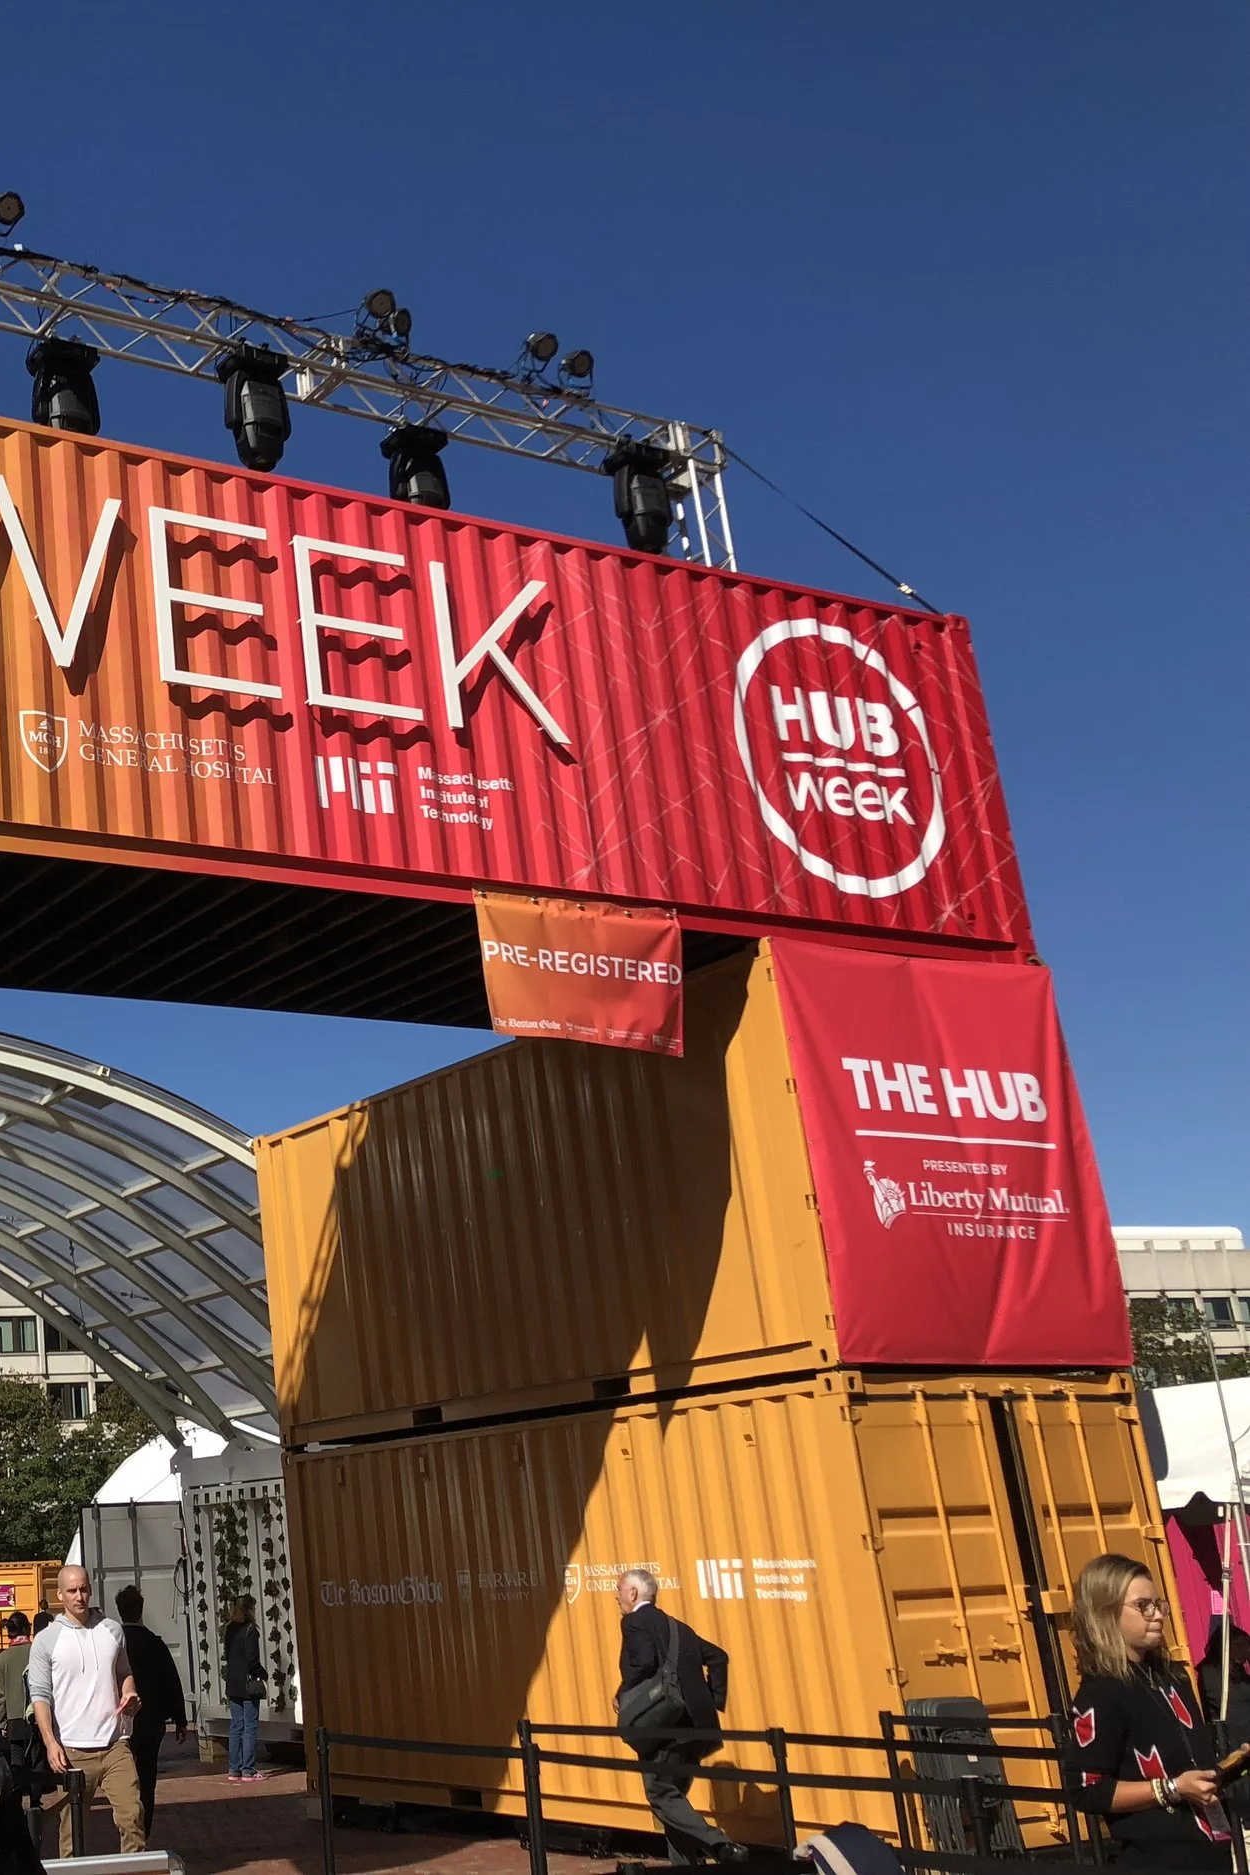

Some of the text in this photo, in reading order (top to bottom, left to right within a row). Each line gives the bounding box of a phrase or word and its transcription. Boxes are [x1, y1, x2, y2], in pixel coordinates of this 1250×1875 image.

[78, 720, 246, 762] MASSACHUSETTS
[770, 685, 900, 757] HUB
[80, 743, 277, 785] GENERAL HOSPITAL
[482, 940, 682, 985] PRE-REGISTERED
[494, 1017, 507, 1028] The
[508, 1018, 538, 1029] Boston
[538, 1019, 561, 1031] Globe
[841, 1057, 1047, 1123] THE HUB
[922, 1159, 1008, 1176] PRESENTED BY
[906, 1181, 986, 1220] Liberty
[947, 1222, 1037, 1240] INSURANCE
[791, 1573, 805, 1584] of
